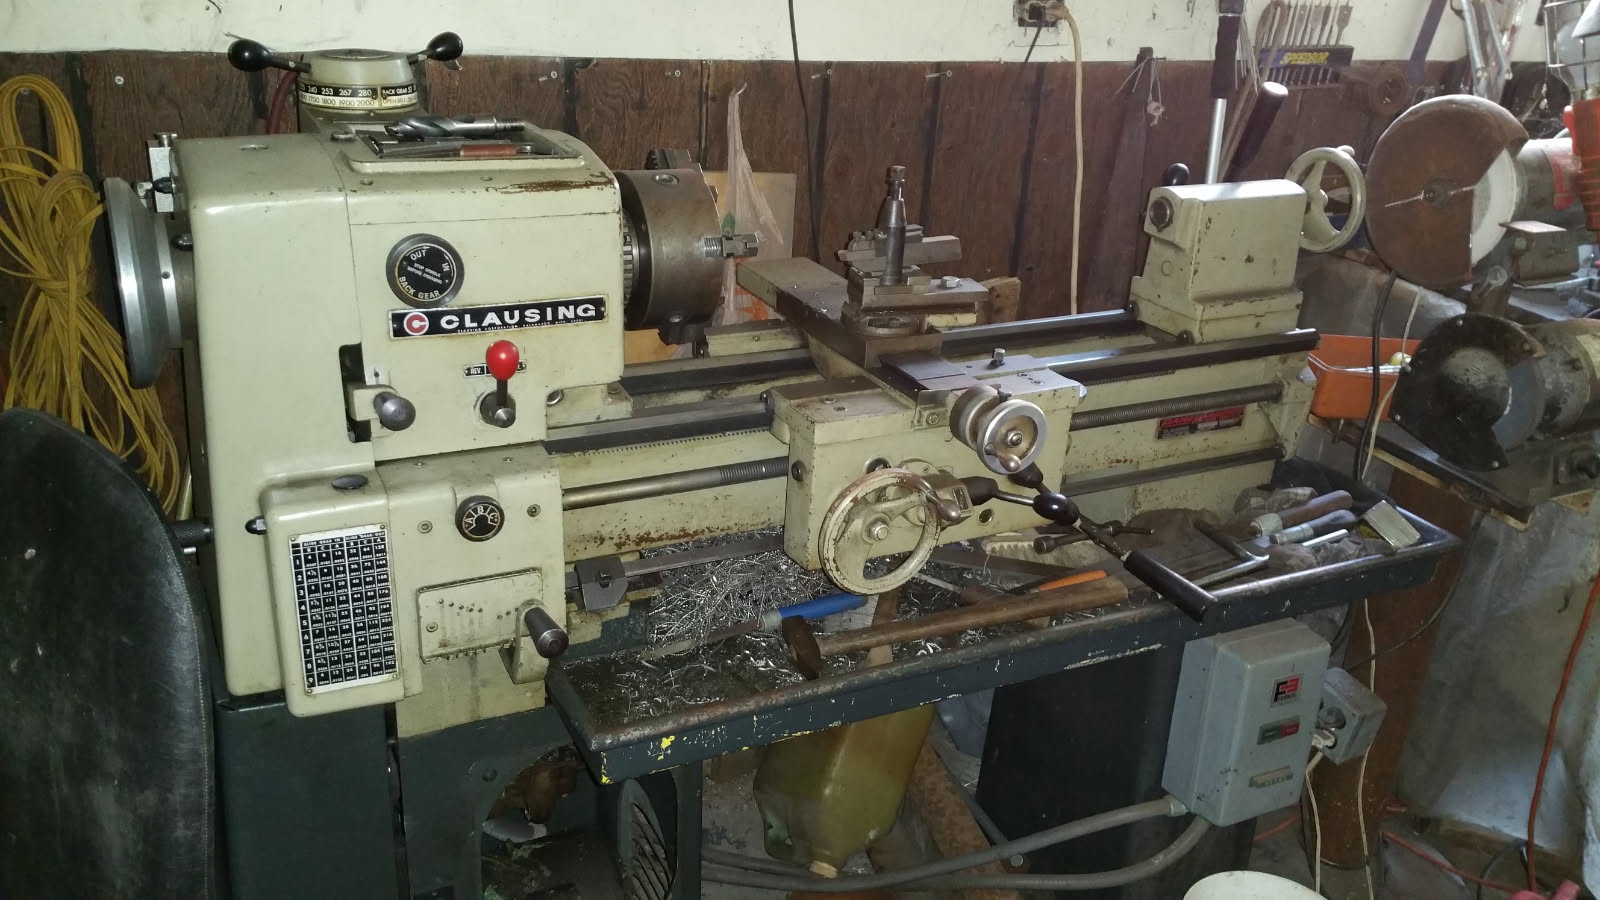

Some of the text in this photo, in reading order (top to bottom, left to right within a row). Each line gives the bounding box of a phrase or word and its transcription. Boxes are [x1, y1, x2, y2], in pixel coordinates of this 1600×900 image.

[358, 89, 372, 97] 280
[321, 98, 336, 106] 1800
[357, 99, 375, 107] 2000
[410, 249, 427, 261] OUT
[442, 262, 450, 272] IN
[399, 276, 440, 300] BACK GEAR
[440, 304, 596, 330] CLAUSING
[470, 367, 483, 375] REV.
[477, 505, 485, 514] B
